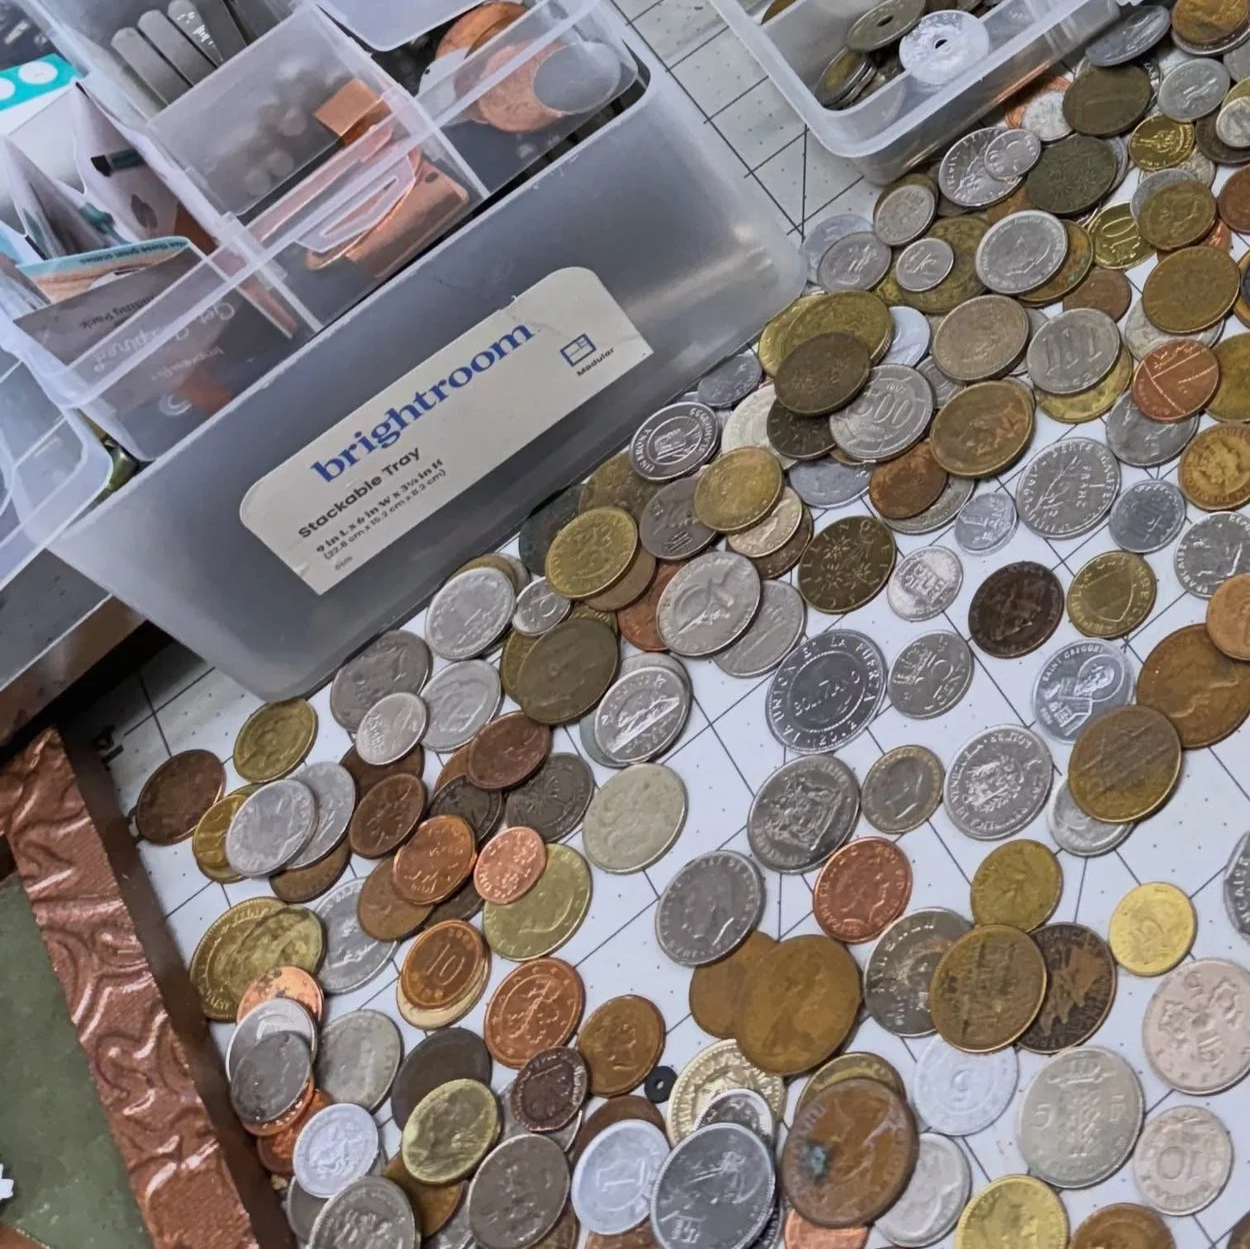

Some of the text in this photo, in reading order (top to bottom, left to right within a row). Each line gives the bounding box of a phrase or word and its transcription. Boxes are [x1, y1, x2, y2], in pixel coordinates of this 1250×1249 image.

[309, 322, 537, 484] brightroom
[575, 346, 616, 378] Modular
[298, 447, 420, 538] Stackable Tray
[326, 534, 340, 547] in
[364, 505, 379, 519] in
[379, 496, 392, 508] W
[417, 468, 433, 481] in
